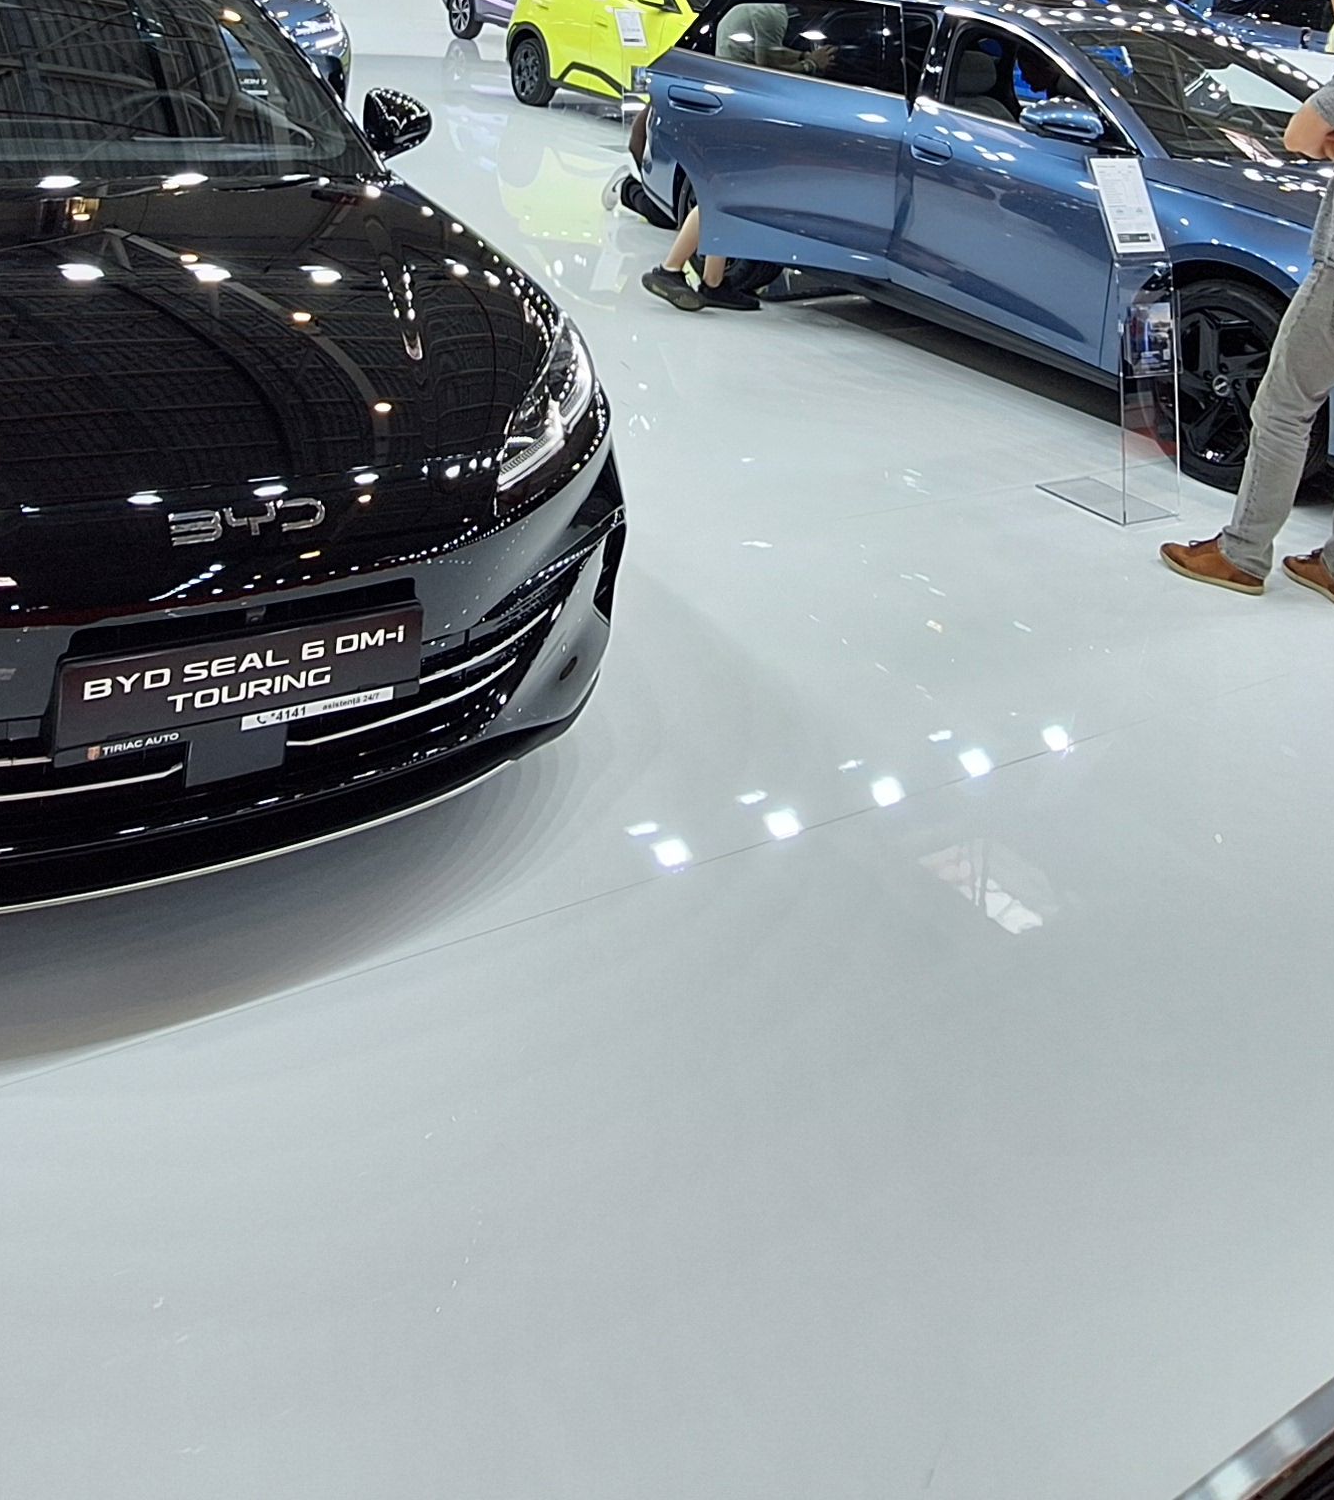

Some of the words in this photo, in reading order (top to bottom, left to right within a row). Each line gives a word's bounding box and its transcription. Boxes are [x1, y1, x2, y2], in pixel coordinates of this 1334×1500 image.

[167, 497, 326, 547] BYD
[83, 667, 172, 702] BYD
[183, 649, 290, 684] SEAL
[301, 639, 326, 662] 6
[335, 624, 406, 656] DM-i
[167, 666, 332, 713] TOURING
[102, 739, 144, 756] TIRIAC
[144, 731, 180, 747] AUTO
